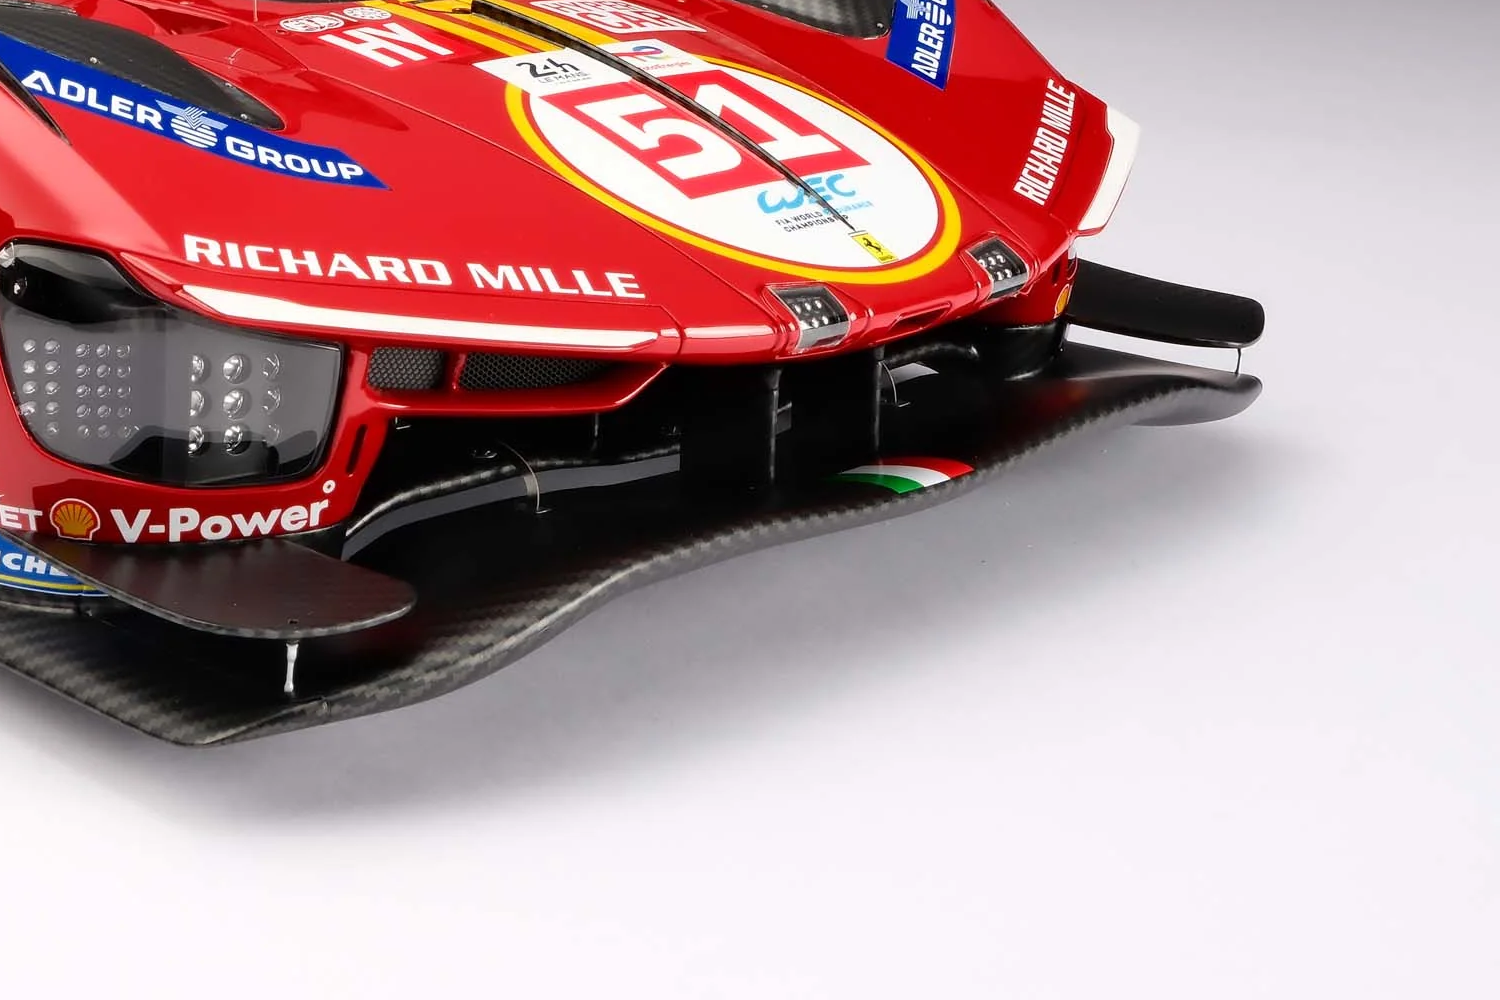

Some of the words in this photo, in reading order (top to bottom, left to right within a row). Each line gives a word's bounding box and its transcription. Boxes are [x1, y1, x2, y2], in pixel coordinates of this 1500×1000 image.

[911, 23, 945, 81] ADLER
[21, 69, 164, 131] ADLER
[224, 135, 364, 181] GROUP
[574, 83, 842, 181] 51
[1013, 127, 1068, 206] RICHARD
[1046, 78, 1076, 135] MILLE
[792, 210, 824, 223] WORLD
[182, 233, 453, 287] RICHARD
[467, 262, 646, 300] MILLE
[110, 499, 329, 542] V-Power
